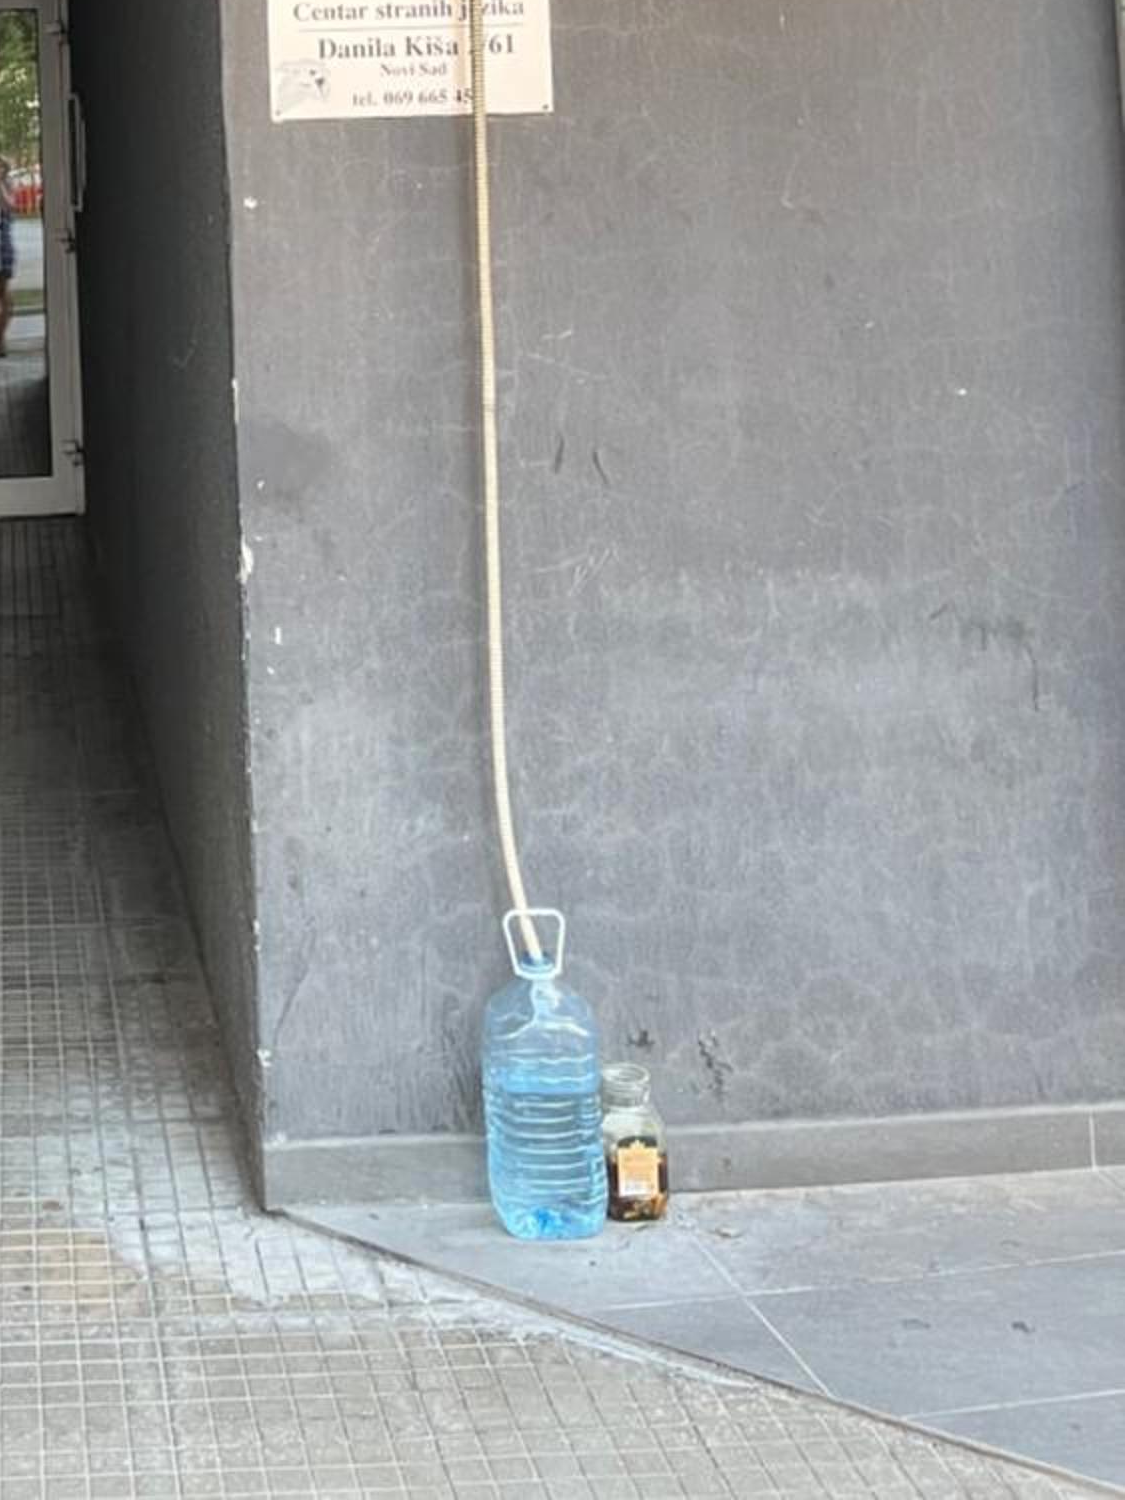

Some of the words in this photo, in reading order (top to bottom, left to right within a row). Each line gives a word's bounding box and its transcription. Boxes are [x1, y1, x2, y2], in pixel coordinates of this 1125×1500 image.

[293, 2, 365, 22] Centar
[318, 37, 396, 60] Danila
[405, 34, 460, 56] Kiša
[380, 62, 415, 77] Novi
[421, 62, 447, 76] Sad
[352, 91, 377, 107] tel.
[383, 90, 413, 106] 069
